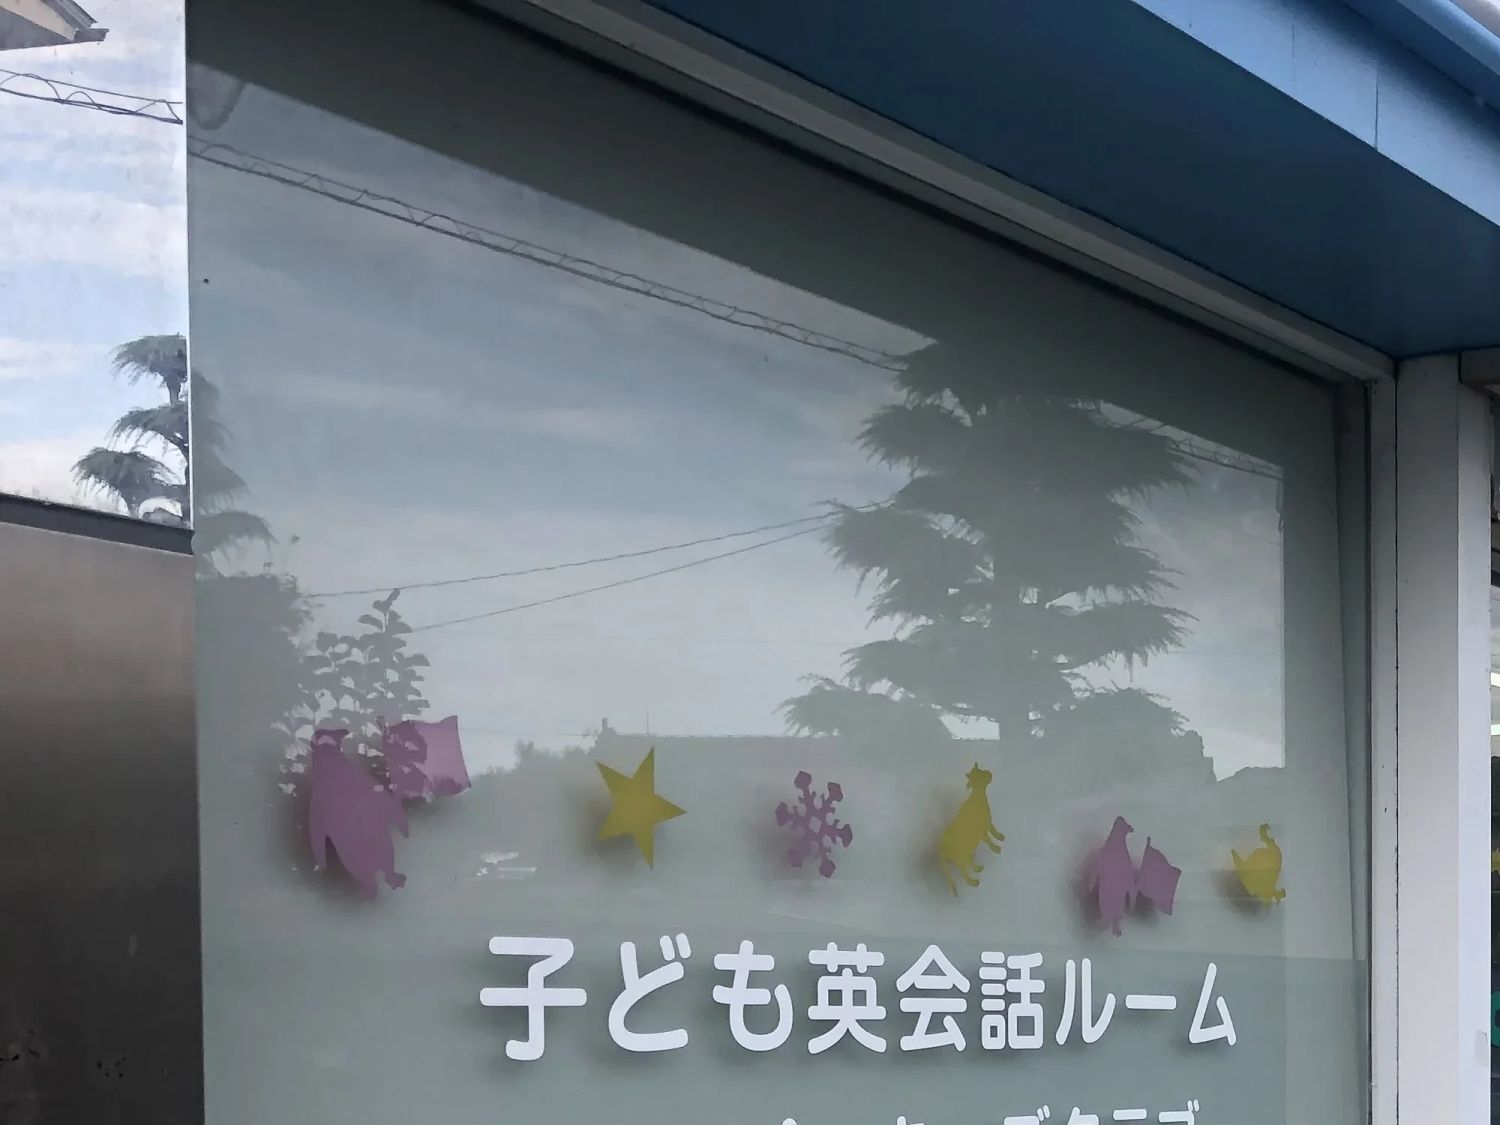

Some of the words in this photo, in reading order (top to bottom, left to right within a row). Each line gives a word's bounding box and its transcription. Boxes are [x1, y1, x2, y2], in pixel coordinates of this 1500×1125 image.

[479, 932, 1238, 1061] 子ども英会話ルーム
